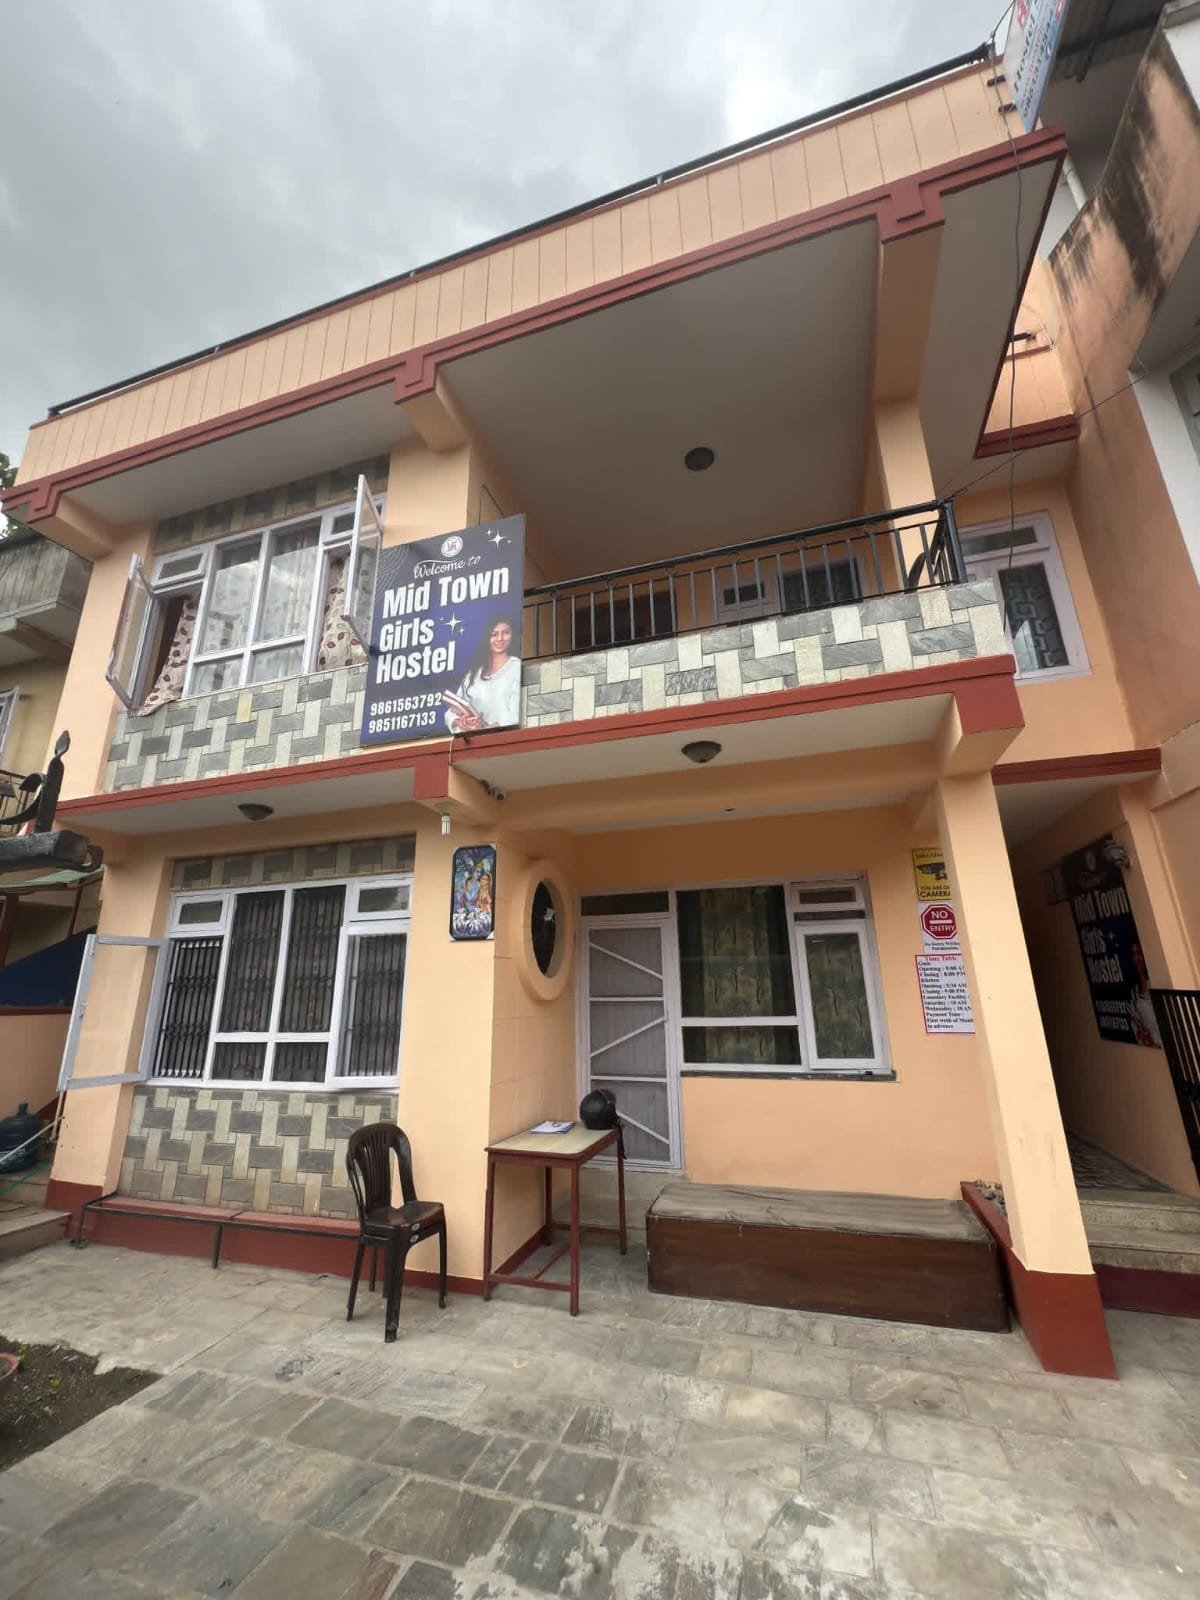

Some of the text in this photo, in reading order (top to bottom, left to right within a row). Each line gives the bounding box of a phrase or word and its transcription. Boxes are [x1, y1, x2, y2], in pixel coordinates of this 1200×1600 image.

[413, 555, 482, 579] Welcome to
[382, 567, 510, 619] Mid Town
[379, 617, 435, 652] Girls
[376, 640, 456, 684] Hostel
[370, 692, 442, 716] 9861563792
[368, 710, 436, 734] 9851167133
[931, 910, 948, 919] NO
[1094, 887, 1130, 919] Town
